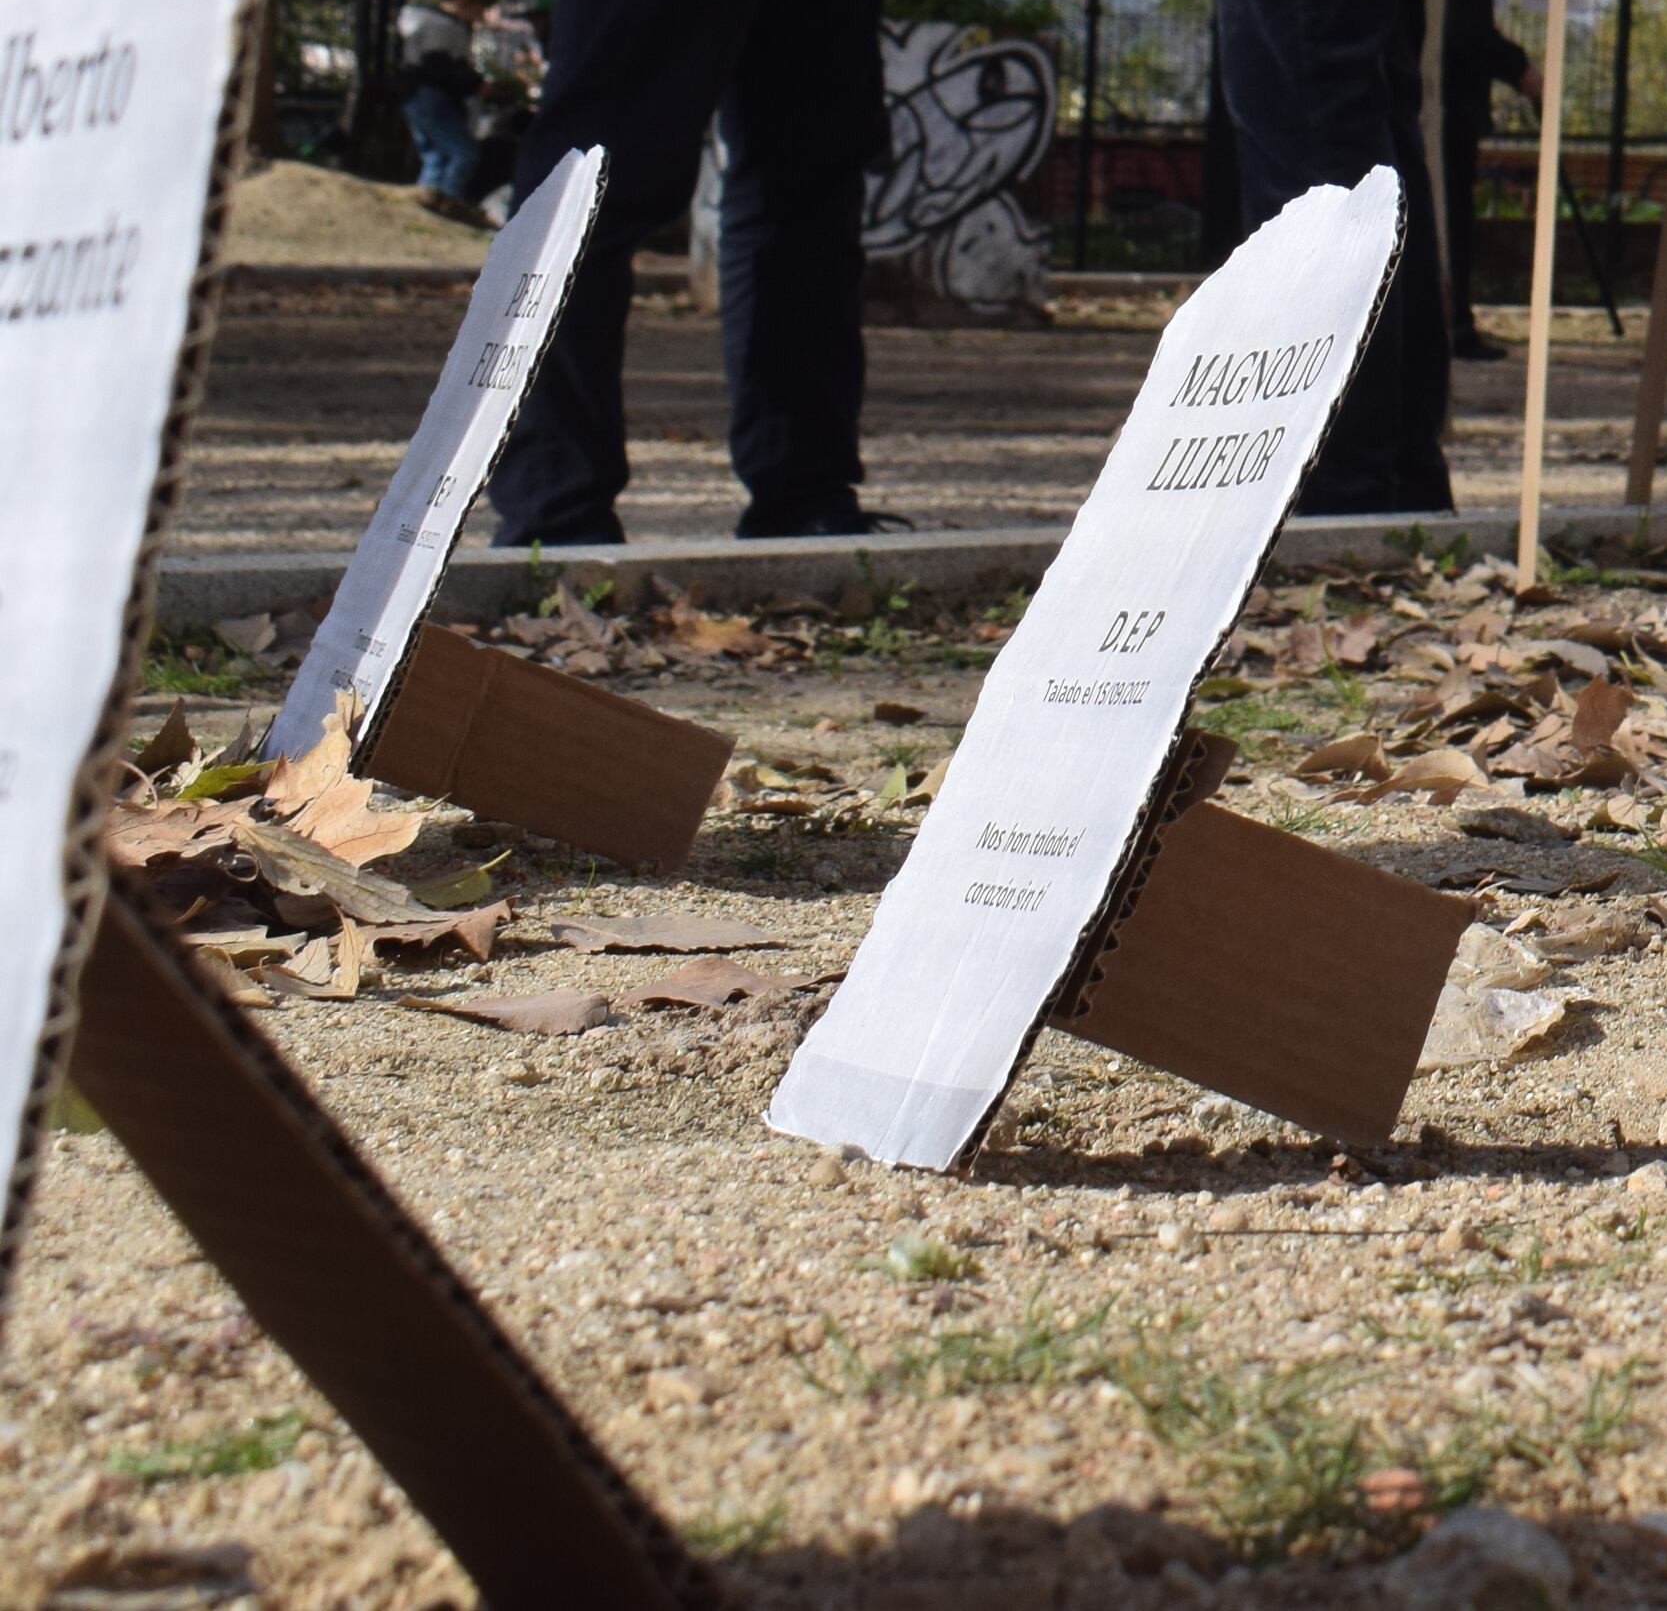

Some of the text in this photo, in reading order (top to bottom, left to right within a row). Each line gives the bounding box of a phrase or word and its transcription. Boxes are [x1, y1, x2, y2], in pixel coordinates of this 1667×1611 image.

[0, 30, 138, 141] lberto
[1169, 333, 1335, 407] MAGNOLIO
[1146, 426, 1286, 490] LILIFLOR
[1098, 610, 1166, 653] D.E.P
[1043, 678, 1151, 706] Talado el 15/09/2022
[975, 821, 1087, 858] Nos han talado el
[964, 877, 1016, 909] corazón
[1011, 880, 1036, 912] sin
